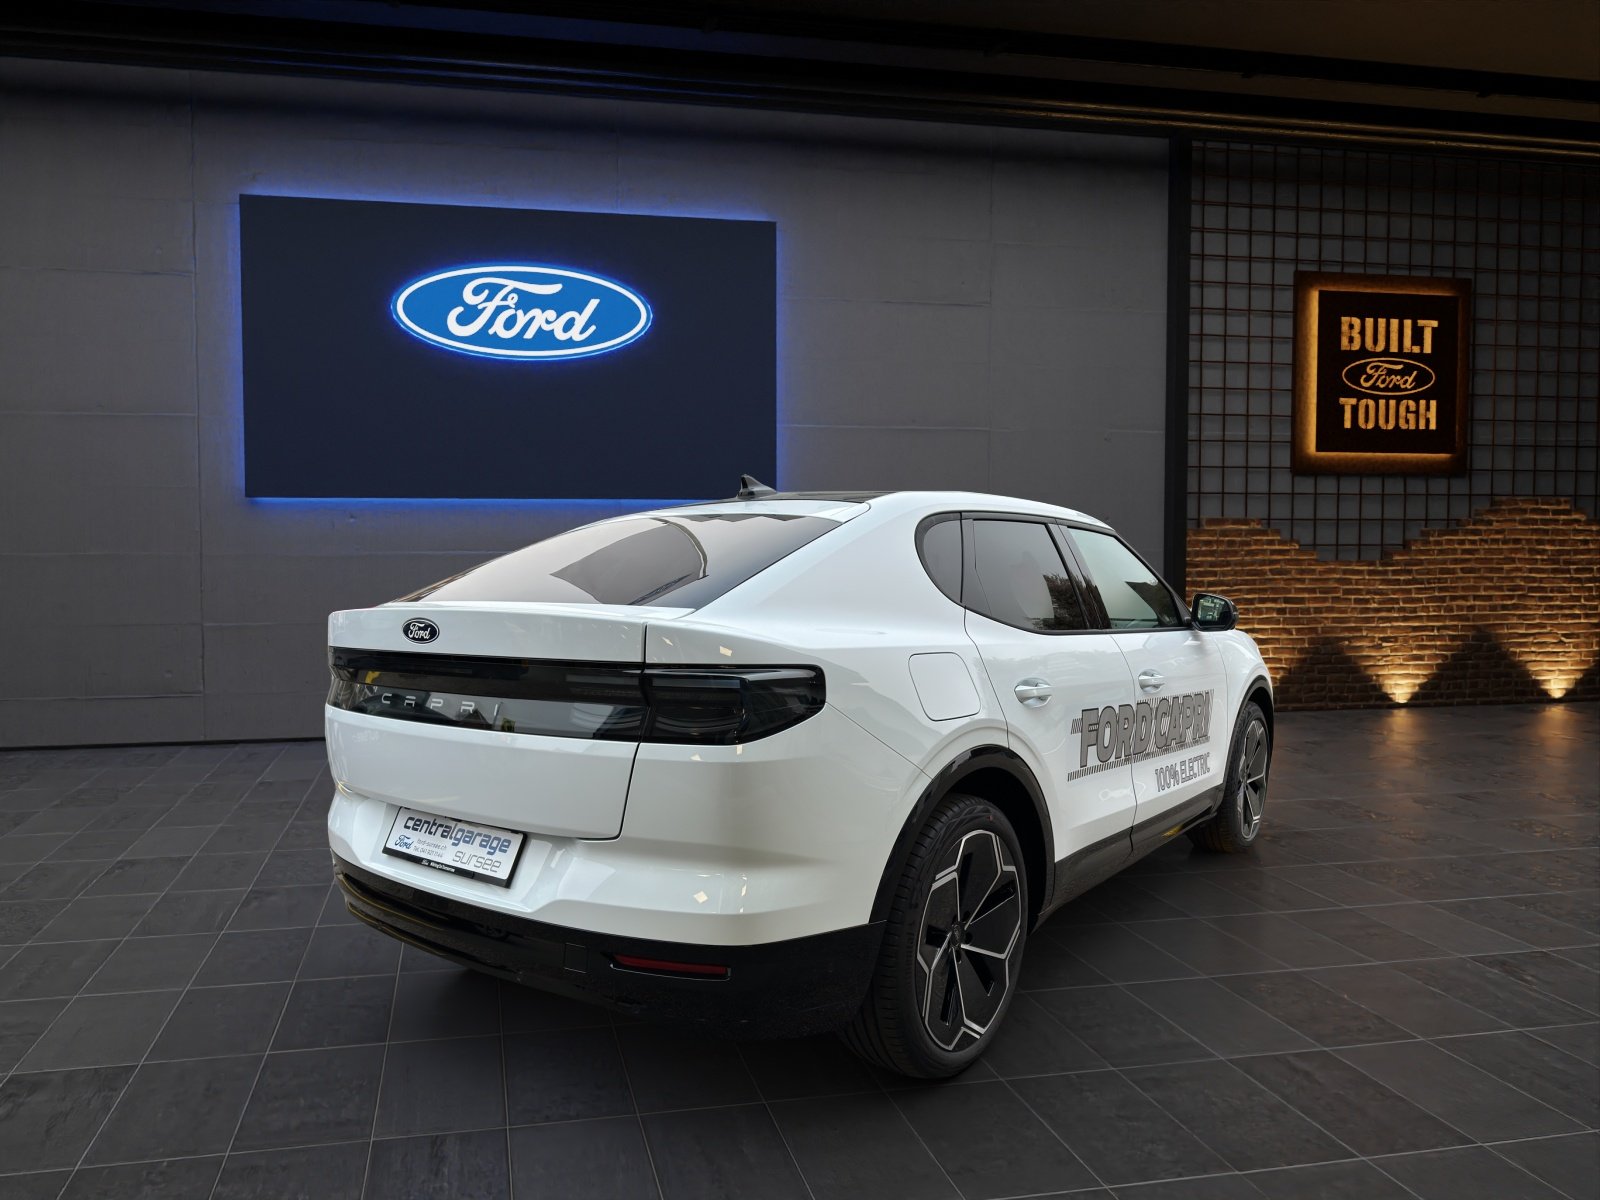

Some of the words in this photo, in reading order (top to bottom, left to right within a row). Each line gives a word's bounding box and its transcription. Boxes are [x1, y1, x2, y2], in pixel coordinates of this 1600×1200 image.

[447, 277, 600, 342] Ford
[1340, 316, 1439, 354] BUILT
[1360, 362, 1418, 389] Ford
[1339, 397, 1437, 430] TOUGH
[408, 622, 431, 639] Ford
[381, 693, 499, 716] CAPRI
[1080, 702, 1153, 768] FORD
[1154, 692, 1211, 750] CAPRI
[1155, 762, 1180, 793] 100%
[1180, 752, 1211, 784] ELECTRIC
[394, 834, 415, 850] Ford
[452, 850, 502, 873] sursee
